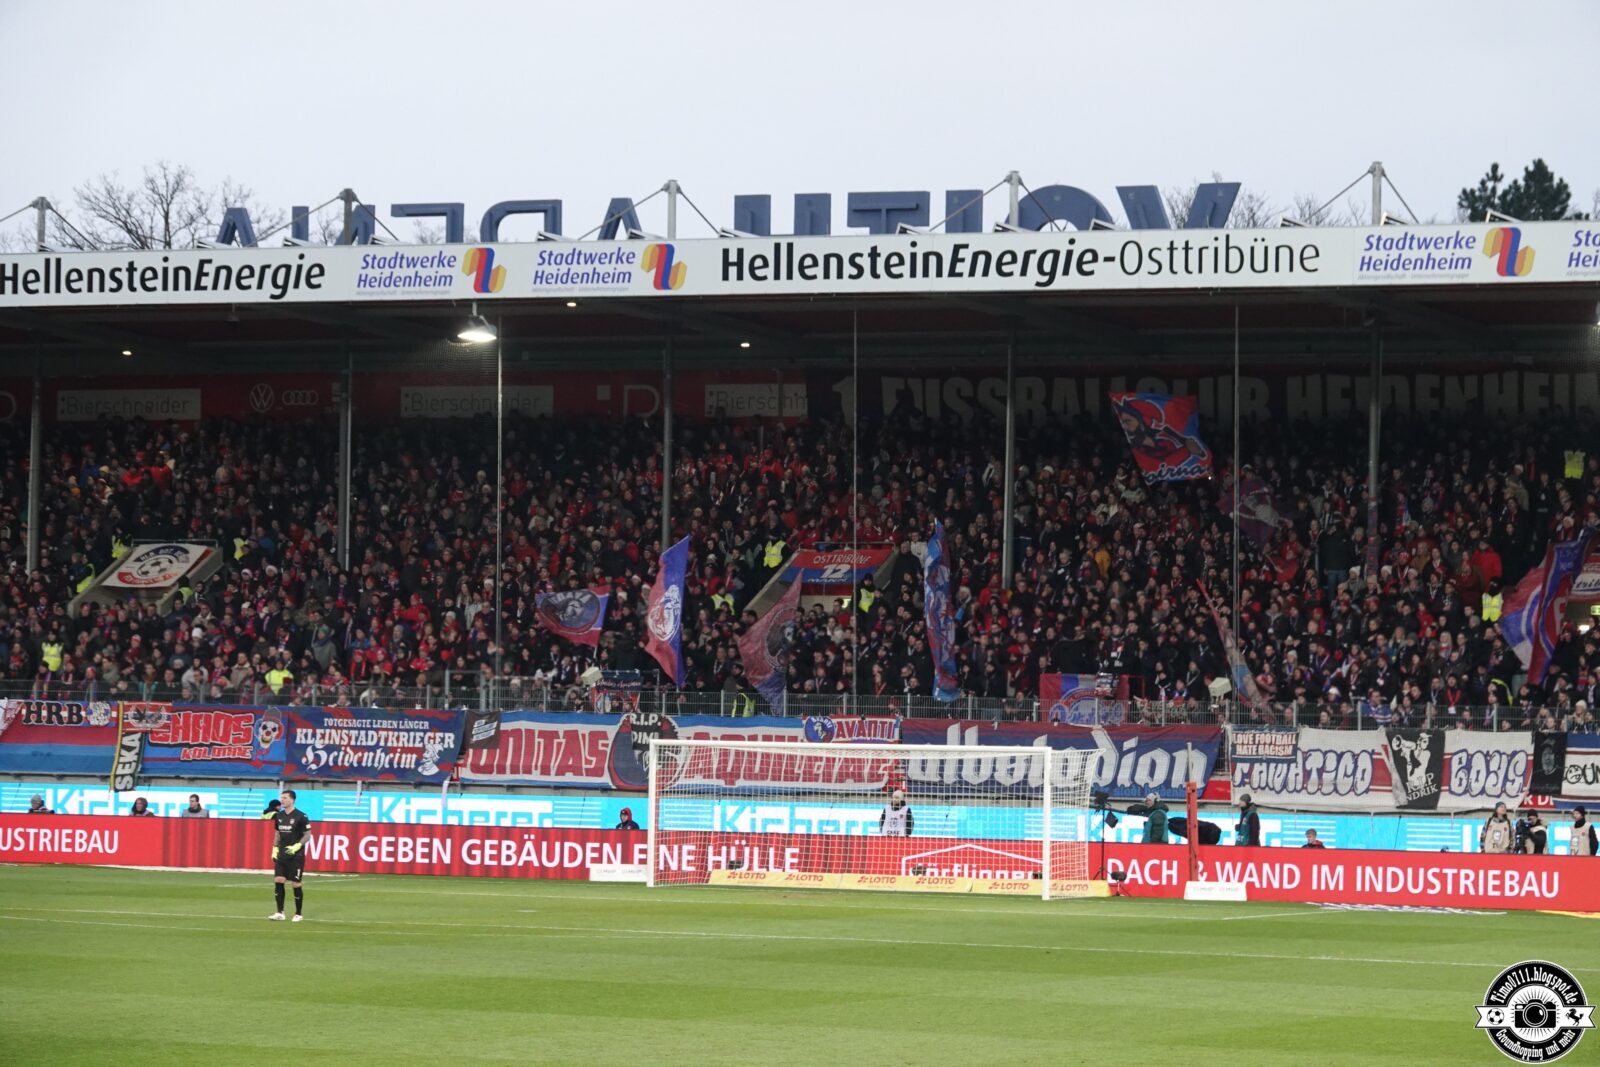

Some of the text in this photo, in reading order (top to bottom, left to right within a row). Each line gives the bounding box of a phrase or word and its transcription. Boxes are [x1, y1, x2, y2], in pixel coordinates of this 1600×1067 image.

[1364, 230, 1476, 251] Stadtwerke
[361, 250, 457, 270] Stadtwerke
[537, 247, 636, 266] Stadtwerke
[1359, 252, 1473, 271] Heidenheim
[0, 253, 325, 300] HellensteinEnergie
[356, 271, 454, 288] Heidenheim
[533, 267, 632, 285] Heidenheim
[20, 700, 84, 726] HRB
[323, 718, 430, 729] TOTGESAGTE LEBEN LÄNGER
[835, 720, 895, 739] AVANTI
[295, 728, 456, 748] KLEINSTADTKRIEGER
[1233, 732, 1297, 745] LOVE FOOTBALL
[301, 744, 419, 774] Heidenheim
[1236, 744, 1293, 756] HATE RACISM
[304, 834, 800, 873] WIR GEBEN GEBÄUDEN ENE HÜLLE
[739, 872, 767, 880] LOTTO
[796, 874, 824, 882] LOTTO
[869, 876, 897, 884] LOTTO
[927, 877, 956, 885] LOTTO
[1106, 858, 1178, 885] DACH
[1215, 861, 1301, 890] WAND
[1311, 863, 1344, 891] IM
[1355, 866, 1560, 898] INDUSTRIEBAU
[1000, 882, 1030, 890] LOTTO
